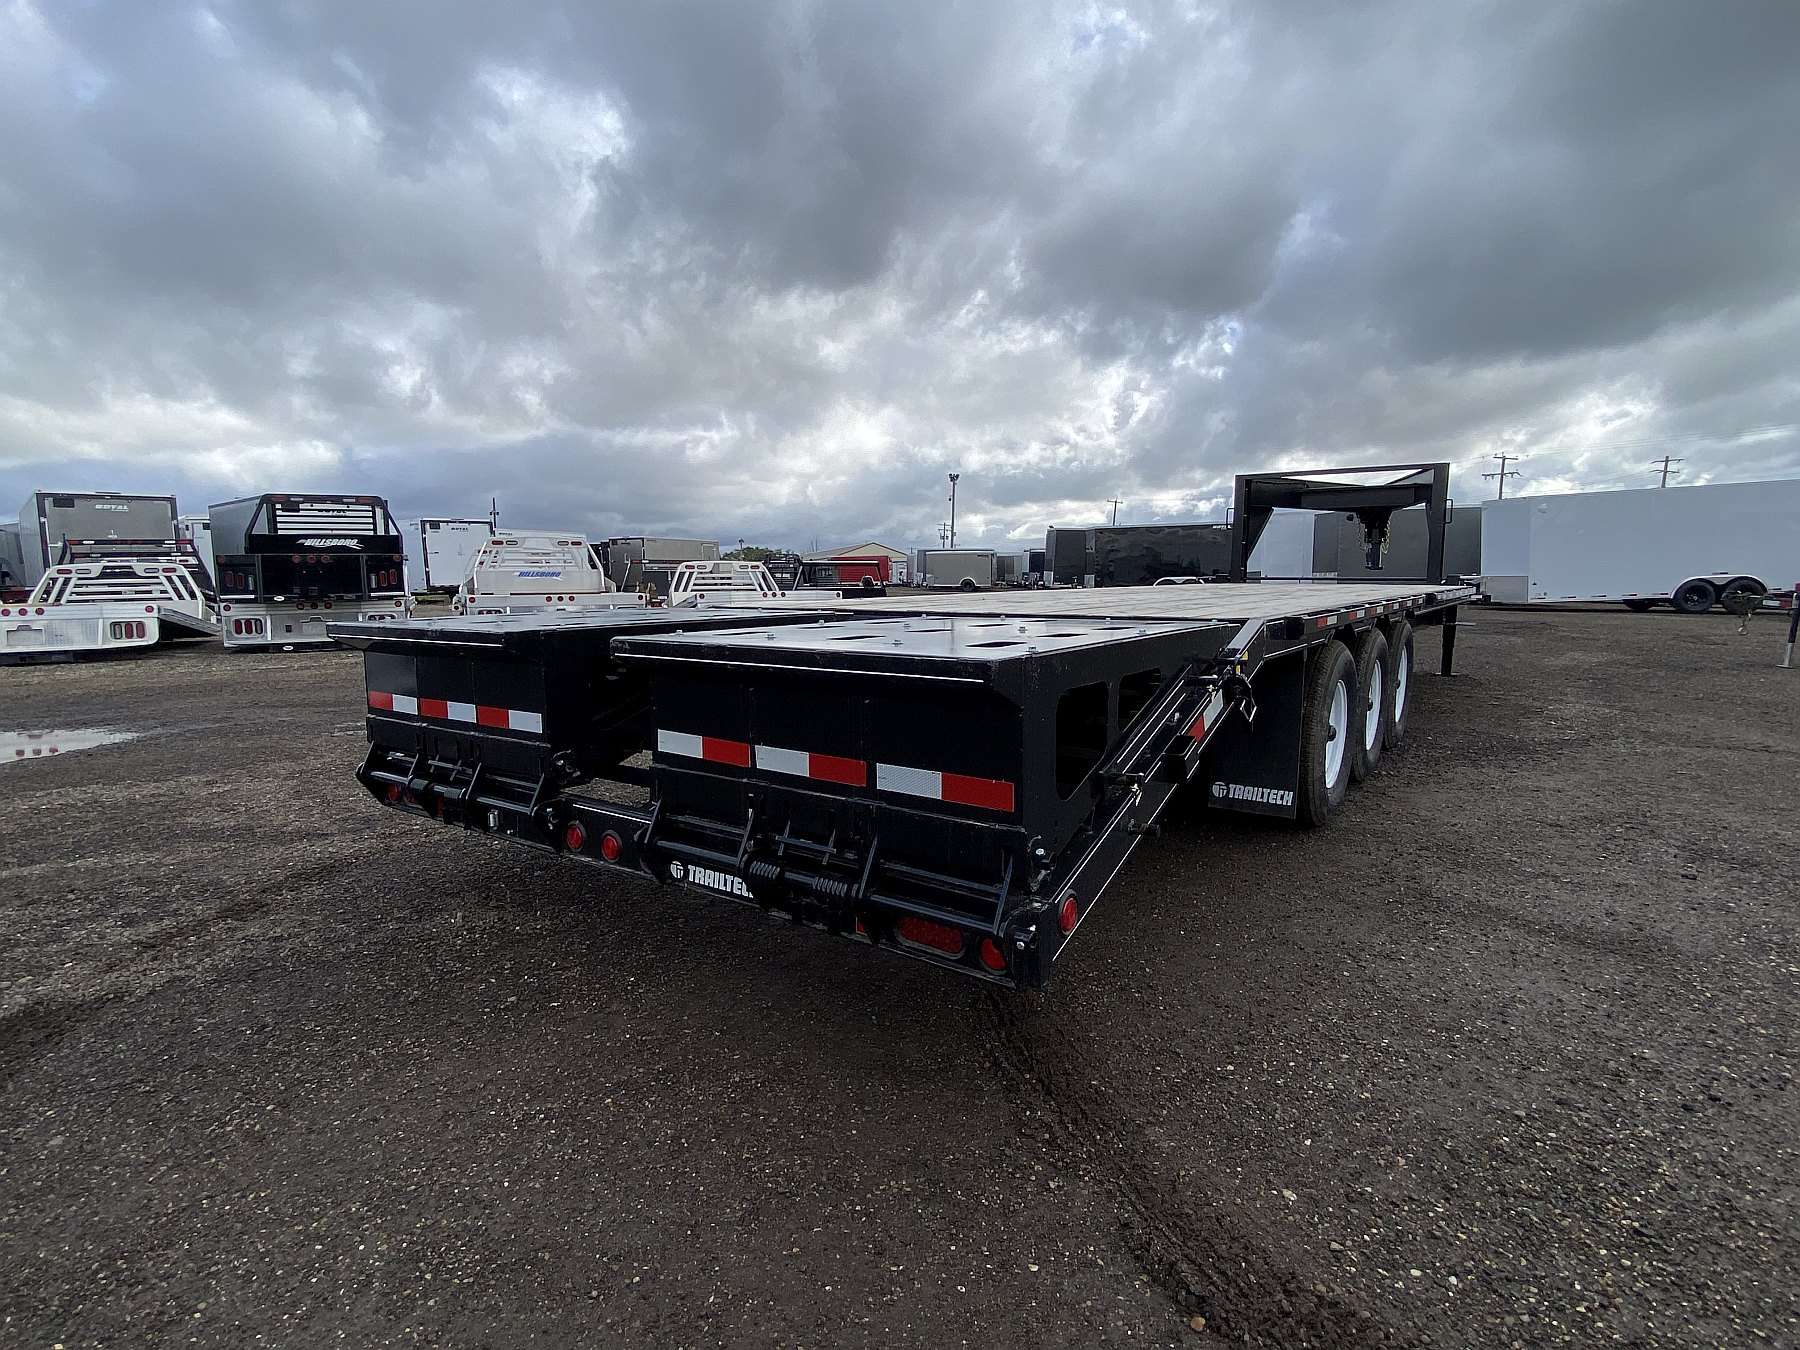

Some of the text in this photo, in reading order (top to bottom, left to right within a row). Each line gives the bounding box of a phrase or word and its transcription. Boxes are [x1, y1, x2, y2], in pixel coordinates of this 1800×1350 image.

[304, 538, 359, 546] HILLSBORO
[1228, 783, 1294, 806] TRAILTECH
[687, 864, 754, 899] TRAILTEC
